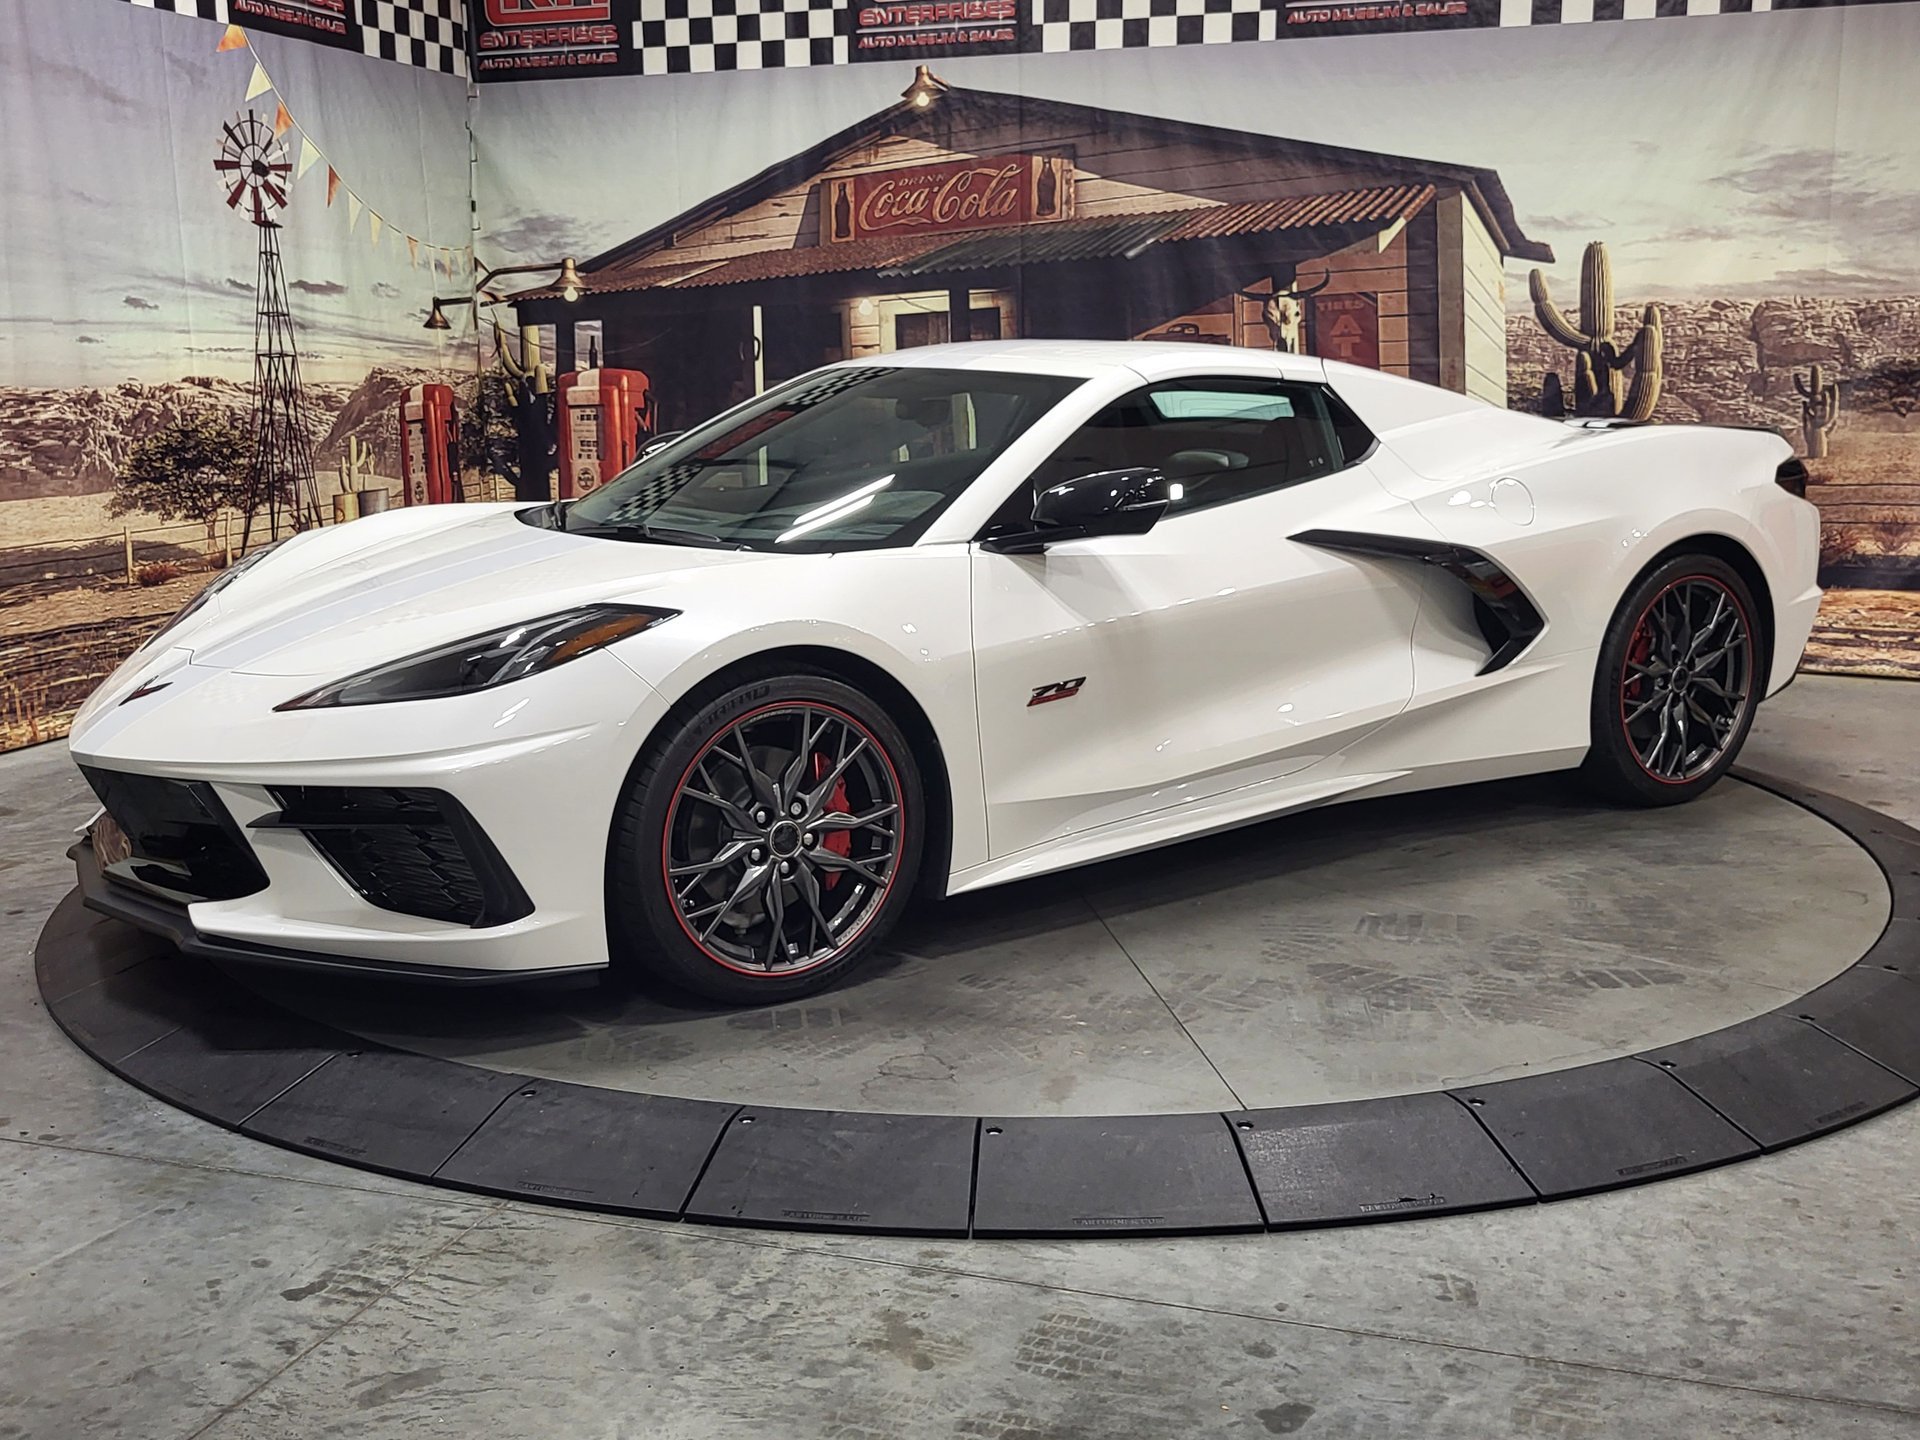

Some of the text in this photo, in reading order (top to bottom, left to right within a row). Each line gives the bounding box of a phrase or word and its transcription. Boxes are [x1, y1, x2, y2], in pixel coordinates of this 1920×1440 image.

[859, 0, 1016, 26] ENTERPRISES
[1287, 1, 1468, 24] AUTO MUSEUM & SALES
[480, 25, 618, 48] ENTERPRISES
[858, 28, 1015, 49] AUTO MUSEUM & SALES
[479, 57, 514, 70] AUTO
[514, 55, 566, 68] MUSEUM
[577, 52, 618, 65] SALES
